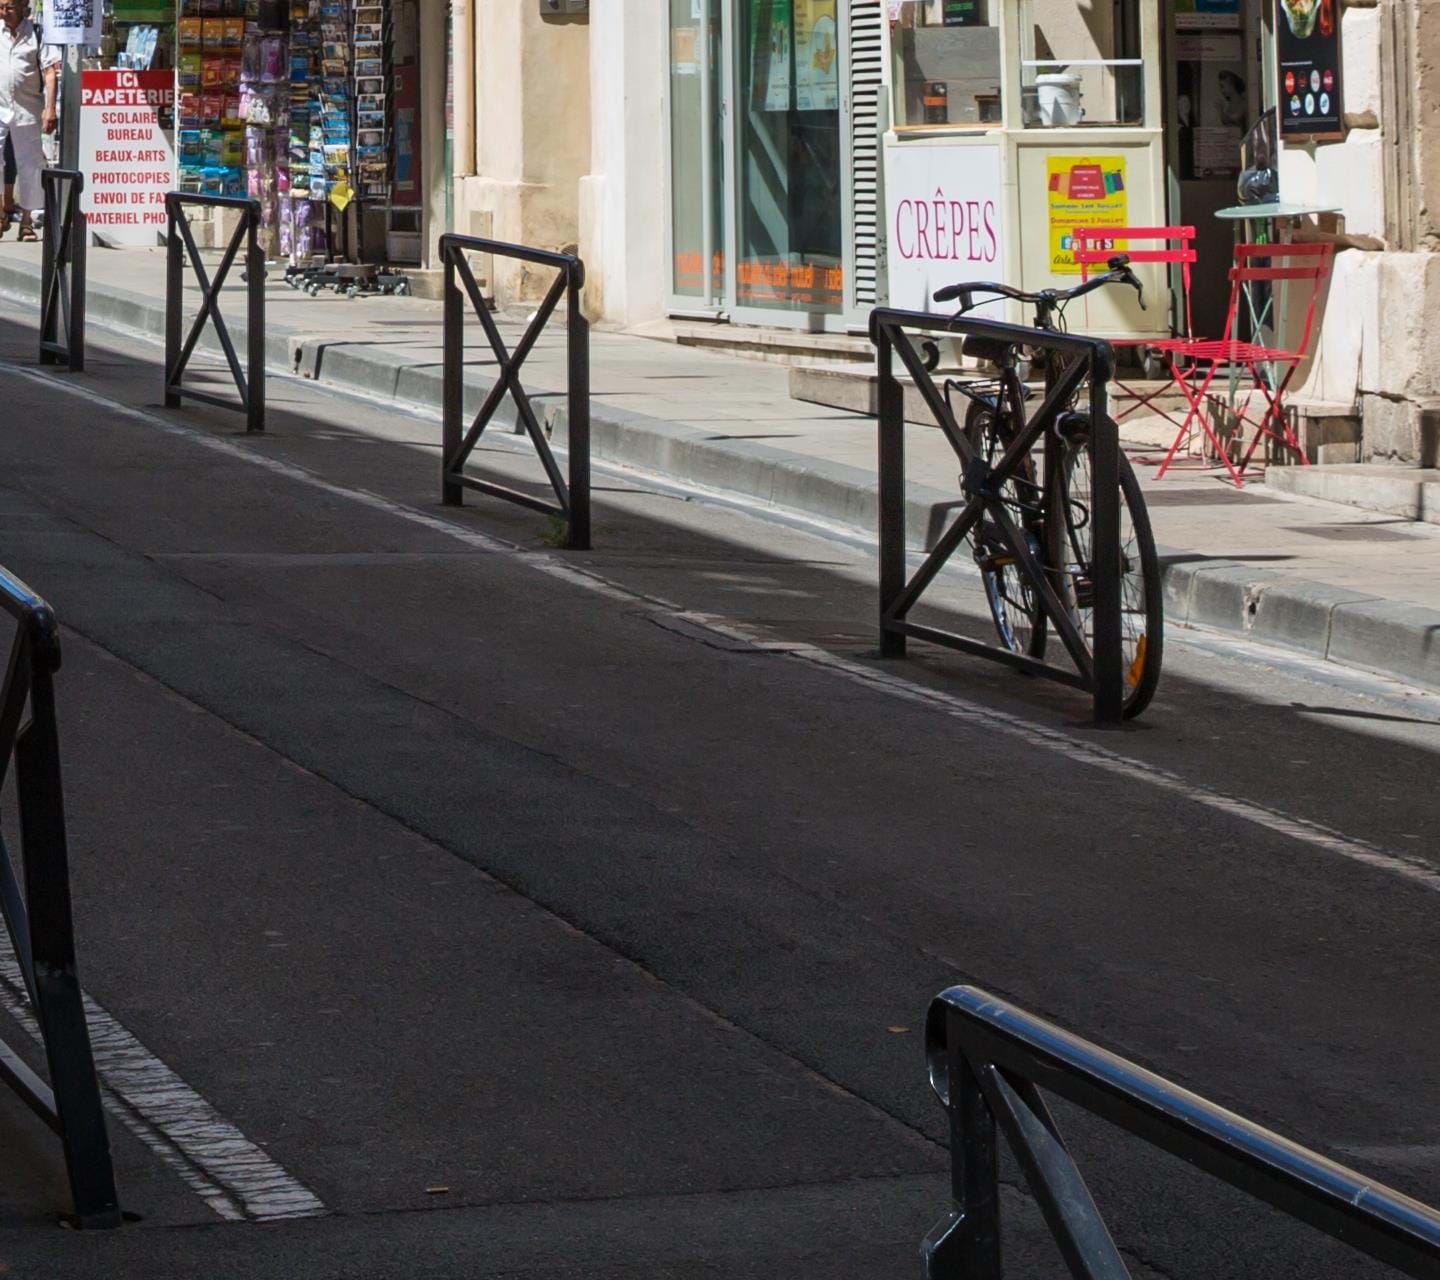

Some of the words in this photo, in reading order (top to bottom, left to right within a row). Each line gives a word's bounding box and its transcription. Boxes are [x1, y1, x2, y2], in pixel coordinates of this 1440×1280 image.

[116, 72, 139, 87] ICI
[81, 89, 174, 105] PAPETERIE
[102, 112, 157, 124] SCOLAIRE
[107, 129, 153, 140] BUREAU
[95, 150, 166, 162] BEAUX-ARTS
[92, 172, 170, 184] PHOTOCOPIES
[94, 192, 127, 204] ENVOI
[131, 192, 145, 204] DE
[85, 212, 139, 224] MATERIEL
[143, 212, 167, 224] PHO
[896, 186, 997, 263] CRÊPES
